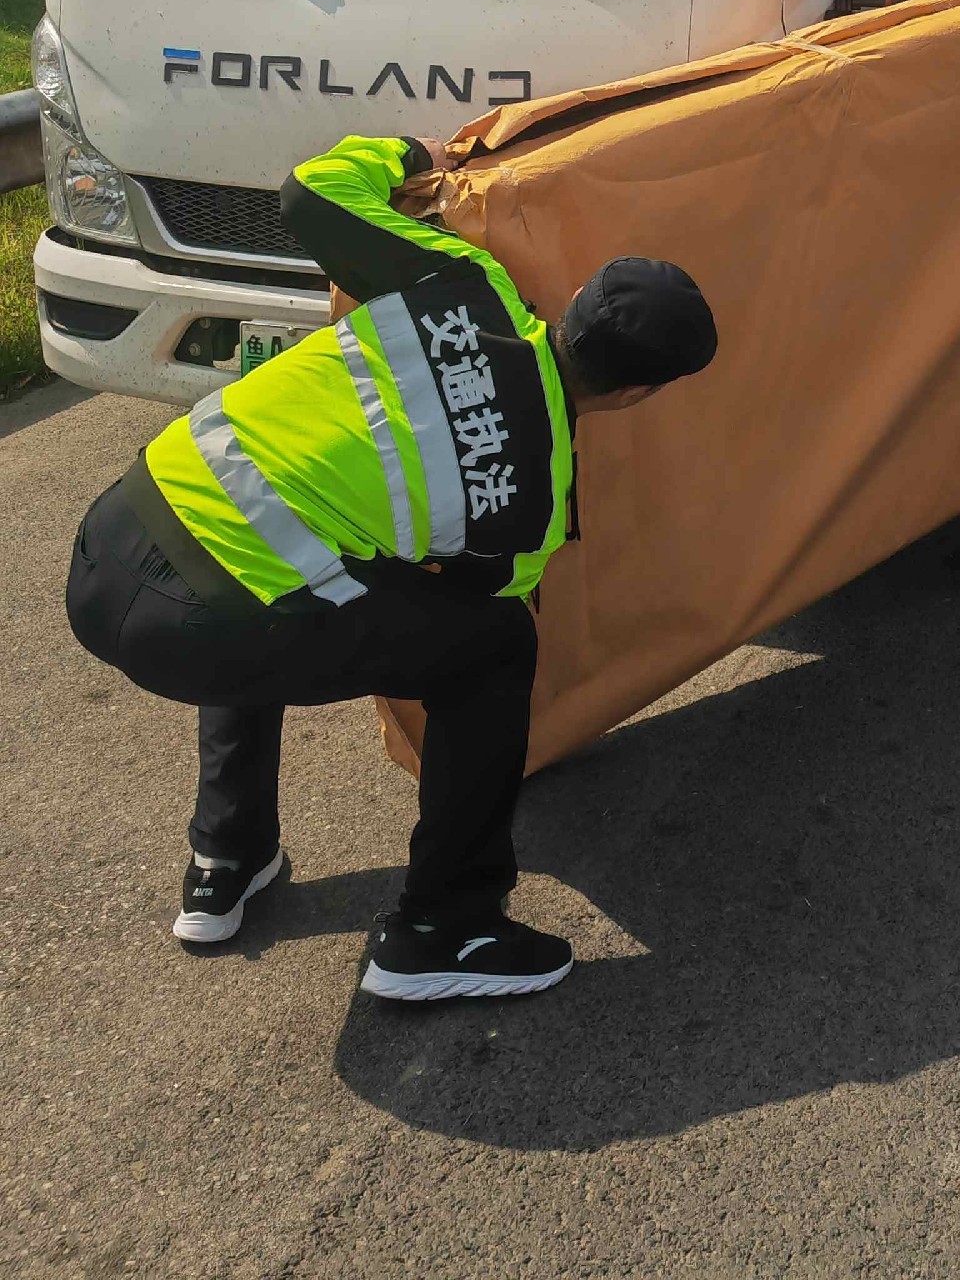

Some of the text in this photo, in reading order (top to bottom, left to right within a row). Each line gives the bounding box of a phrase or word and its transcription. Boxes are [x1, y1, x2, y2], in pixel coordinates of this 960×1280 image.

[163, 47, 531, 106] FORLAND
[420, 305, 518, 520] 交通执法
